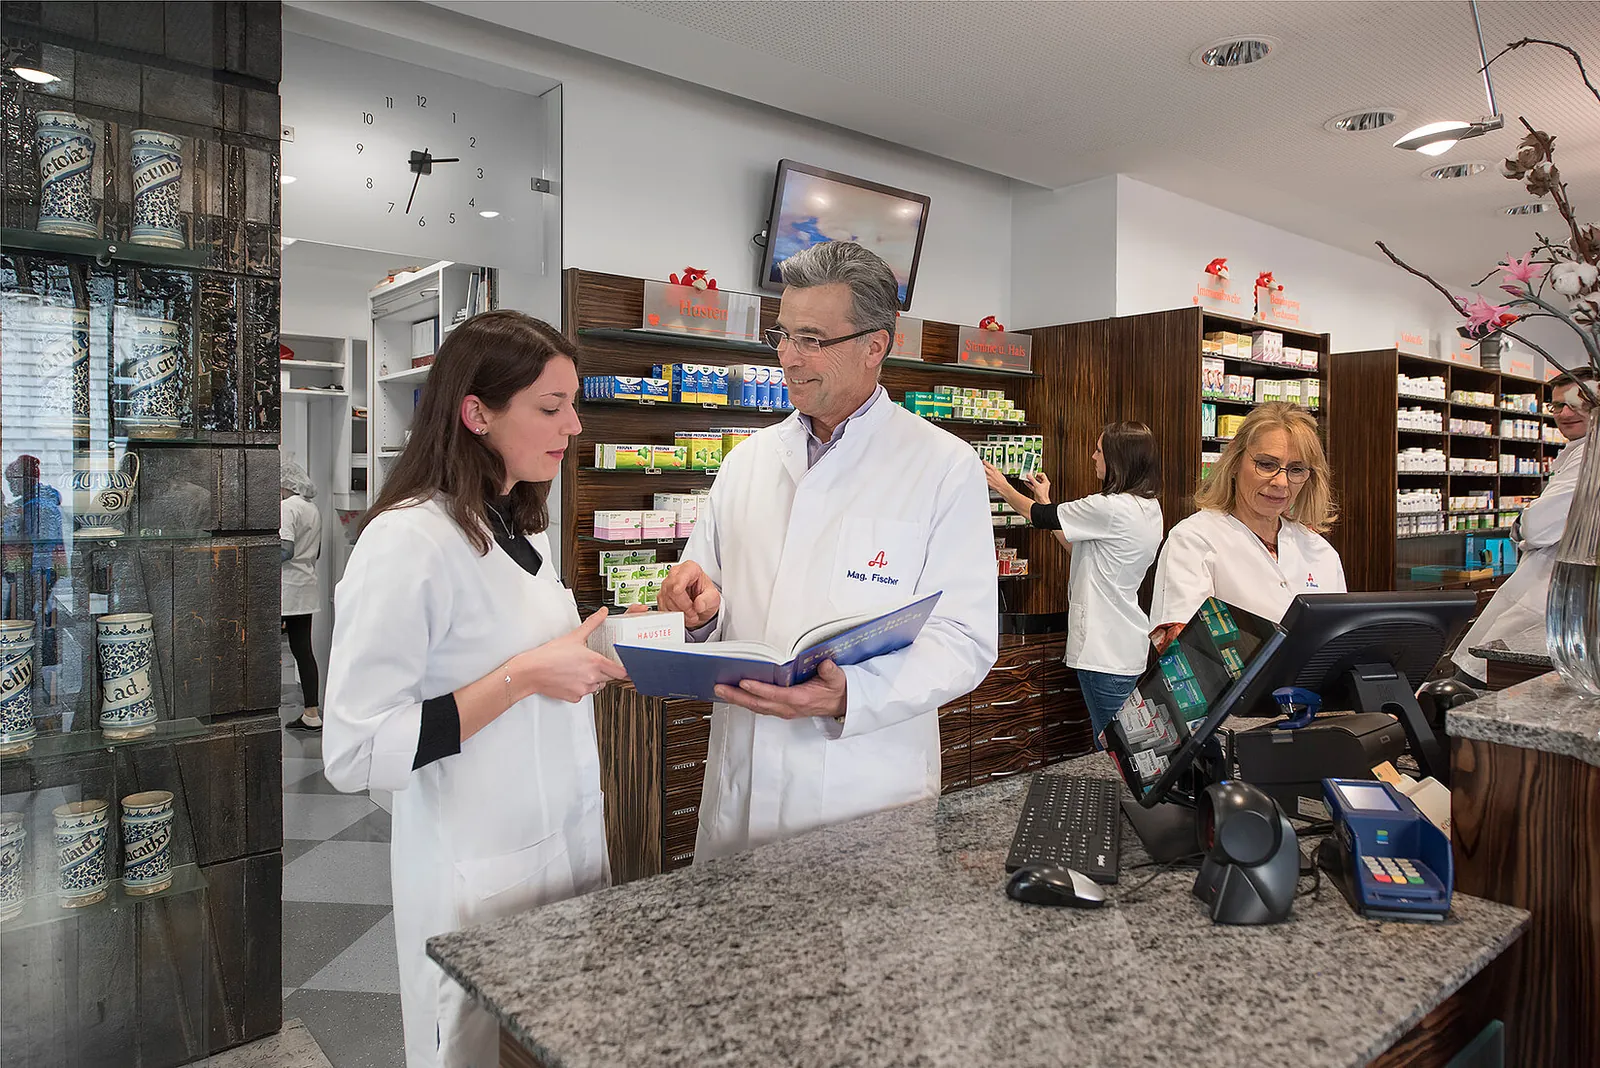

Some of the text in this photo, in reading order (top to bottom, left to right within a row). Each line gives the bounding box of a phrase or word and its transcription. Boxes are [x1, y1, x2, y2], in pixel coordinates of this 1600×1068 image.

[385, 96, 393, 109] 11
[417, 95, 427, 107] 12
[363, 112, 374, 125] 10
[452, 112, 456, 123] 1
[469, 136, 476, 148] 2
[356, 143, 364, 154] 9
[477, 167, 484, 179] 3
[366, 177, 373, 189] 8
[388, 201, 395, 213] 7
[469, 197, 475, 207] 4
[418, 216, 426, 227] 6
[449, 213, 456, 224] 5
[680, 299, 729, 321] Husten
[965, 339, 1026, 357] Stimme u. Hals
[868, 550, 888, 568] A
[847, 569, 899, 585] Mag. Fischer
[637, 628, 672, 639] HAUSTEE
